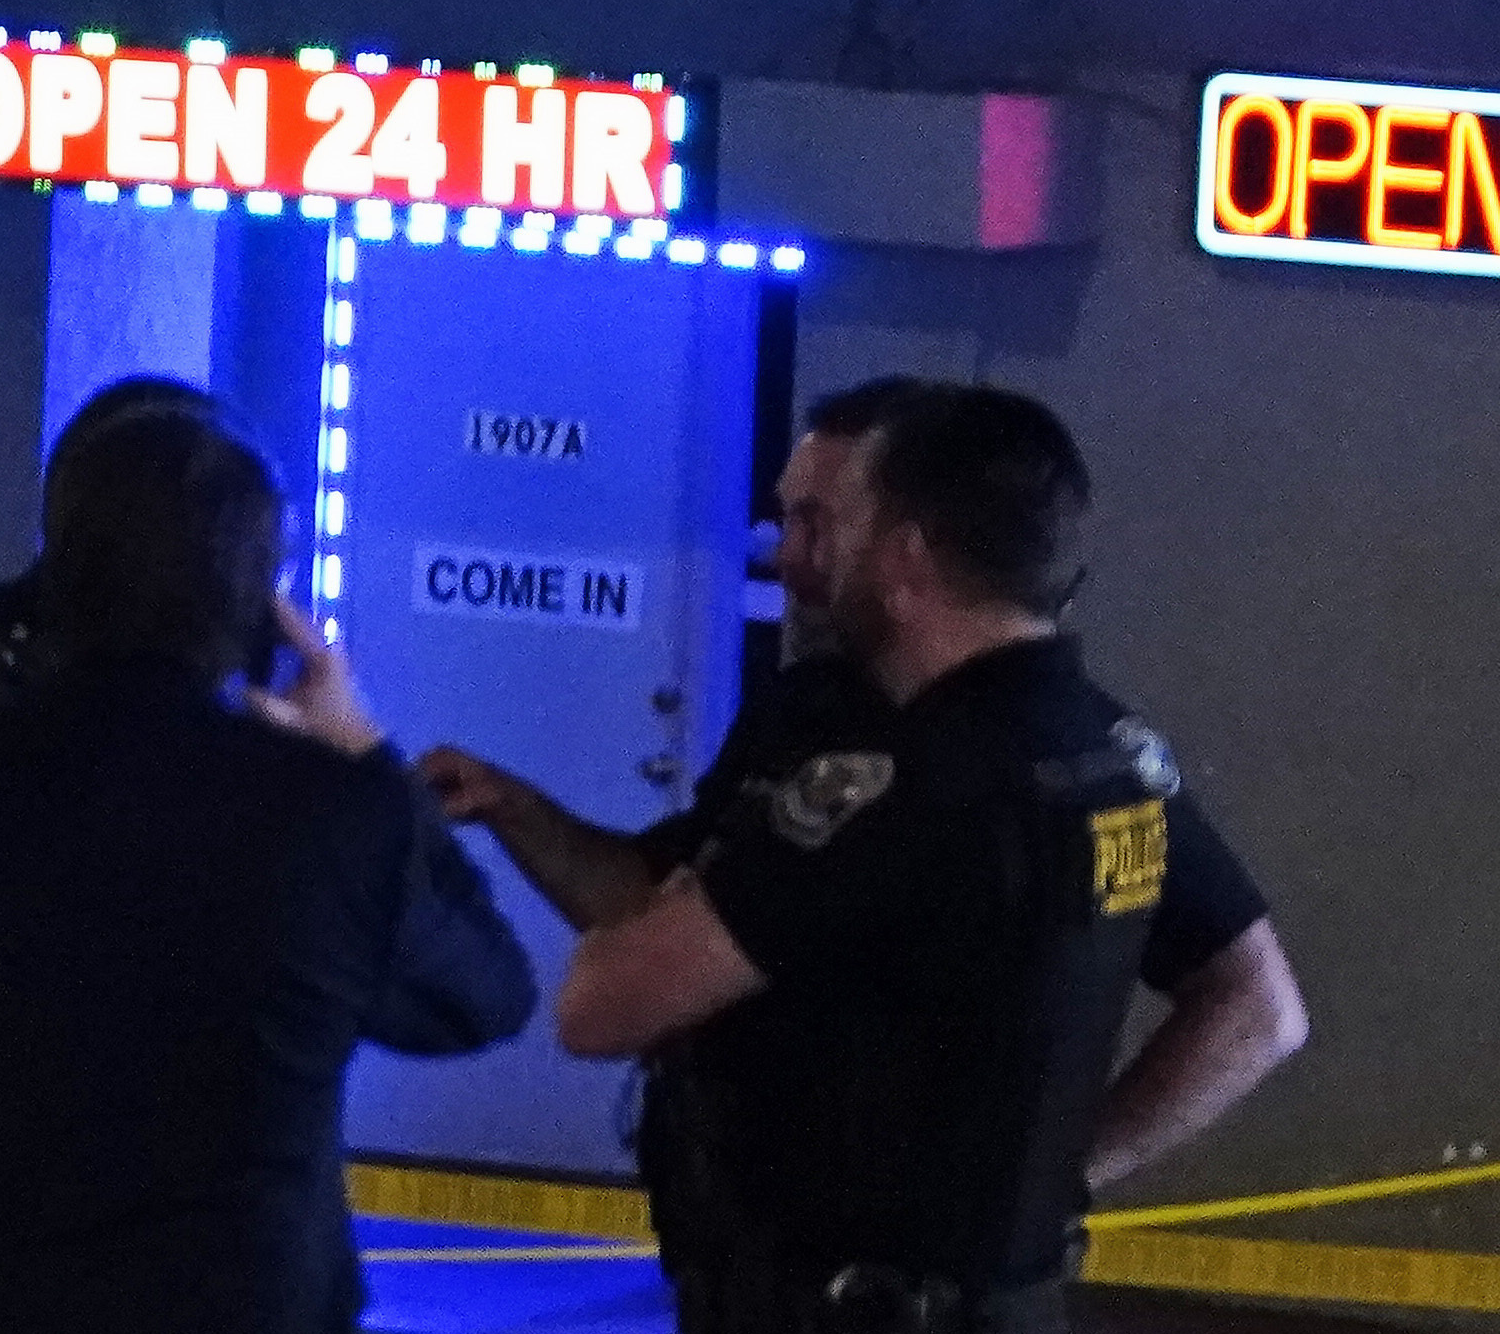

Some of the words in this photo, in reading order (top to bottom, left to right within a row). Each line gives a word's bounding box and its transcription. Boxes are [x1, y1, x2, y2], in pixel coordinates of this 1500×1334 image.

[303, 71, 448, 199] 24
[479, 83, 657, 216] HR
[471, 414, 584, 459] 1907A
[426, 556, 566, 613] COME
[580, 570, 629, 618] IN
